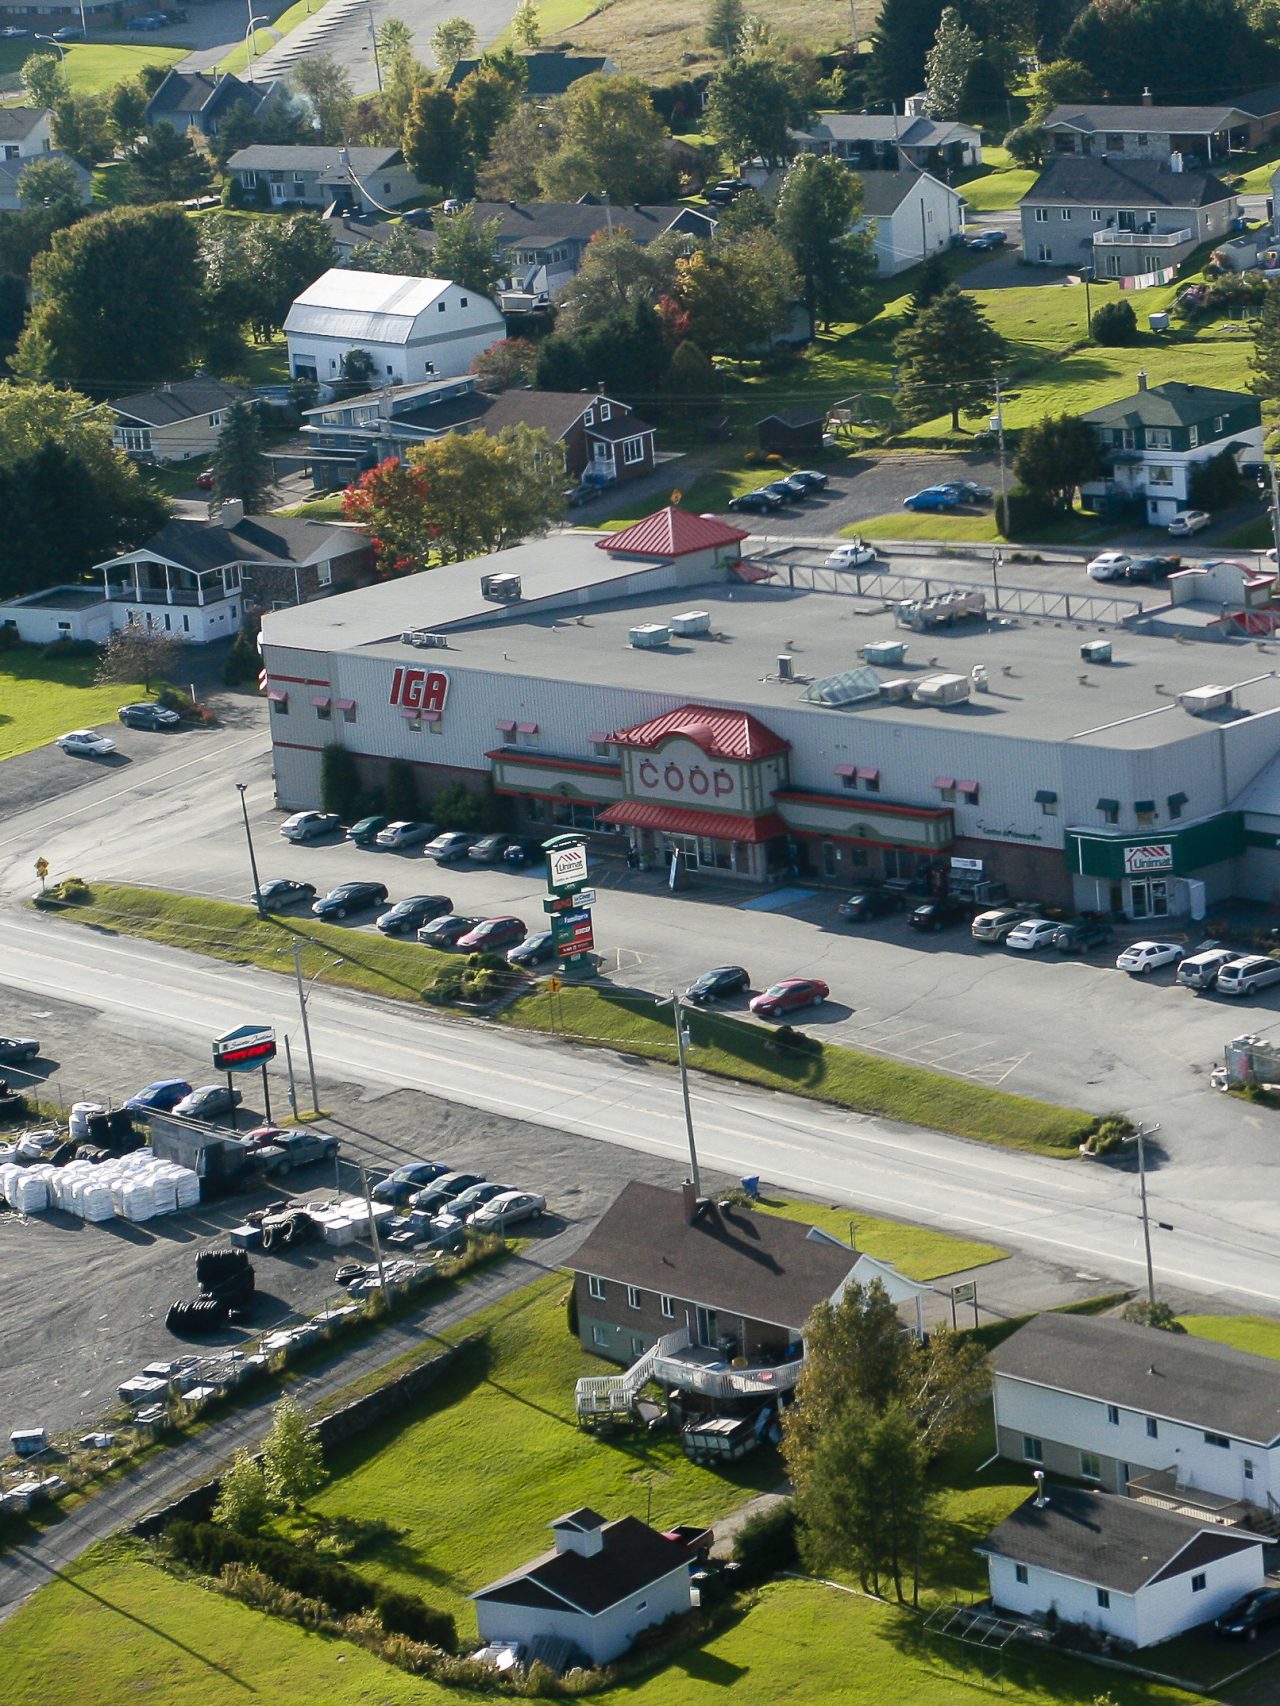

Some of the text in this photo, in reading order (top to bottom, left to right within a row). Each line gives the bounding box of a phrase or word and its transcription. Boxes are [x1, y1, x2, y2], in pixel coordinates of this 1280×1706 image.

[388, 666, 449, 711] IGA
[640, 763, 735, 798] COOP
[559, 860, 583, 872] Unimat
[1134, 857, 1171, 868] Unimat
